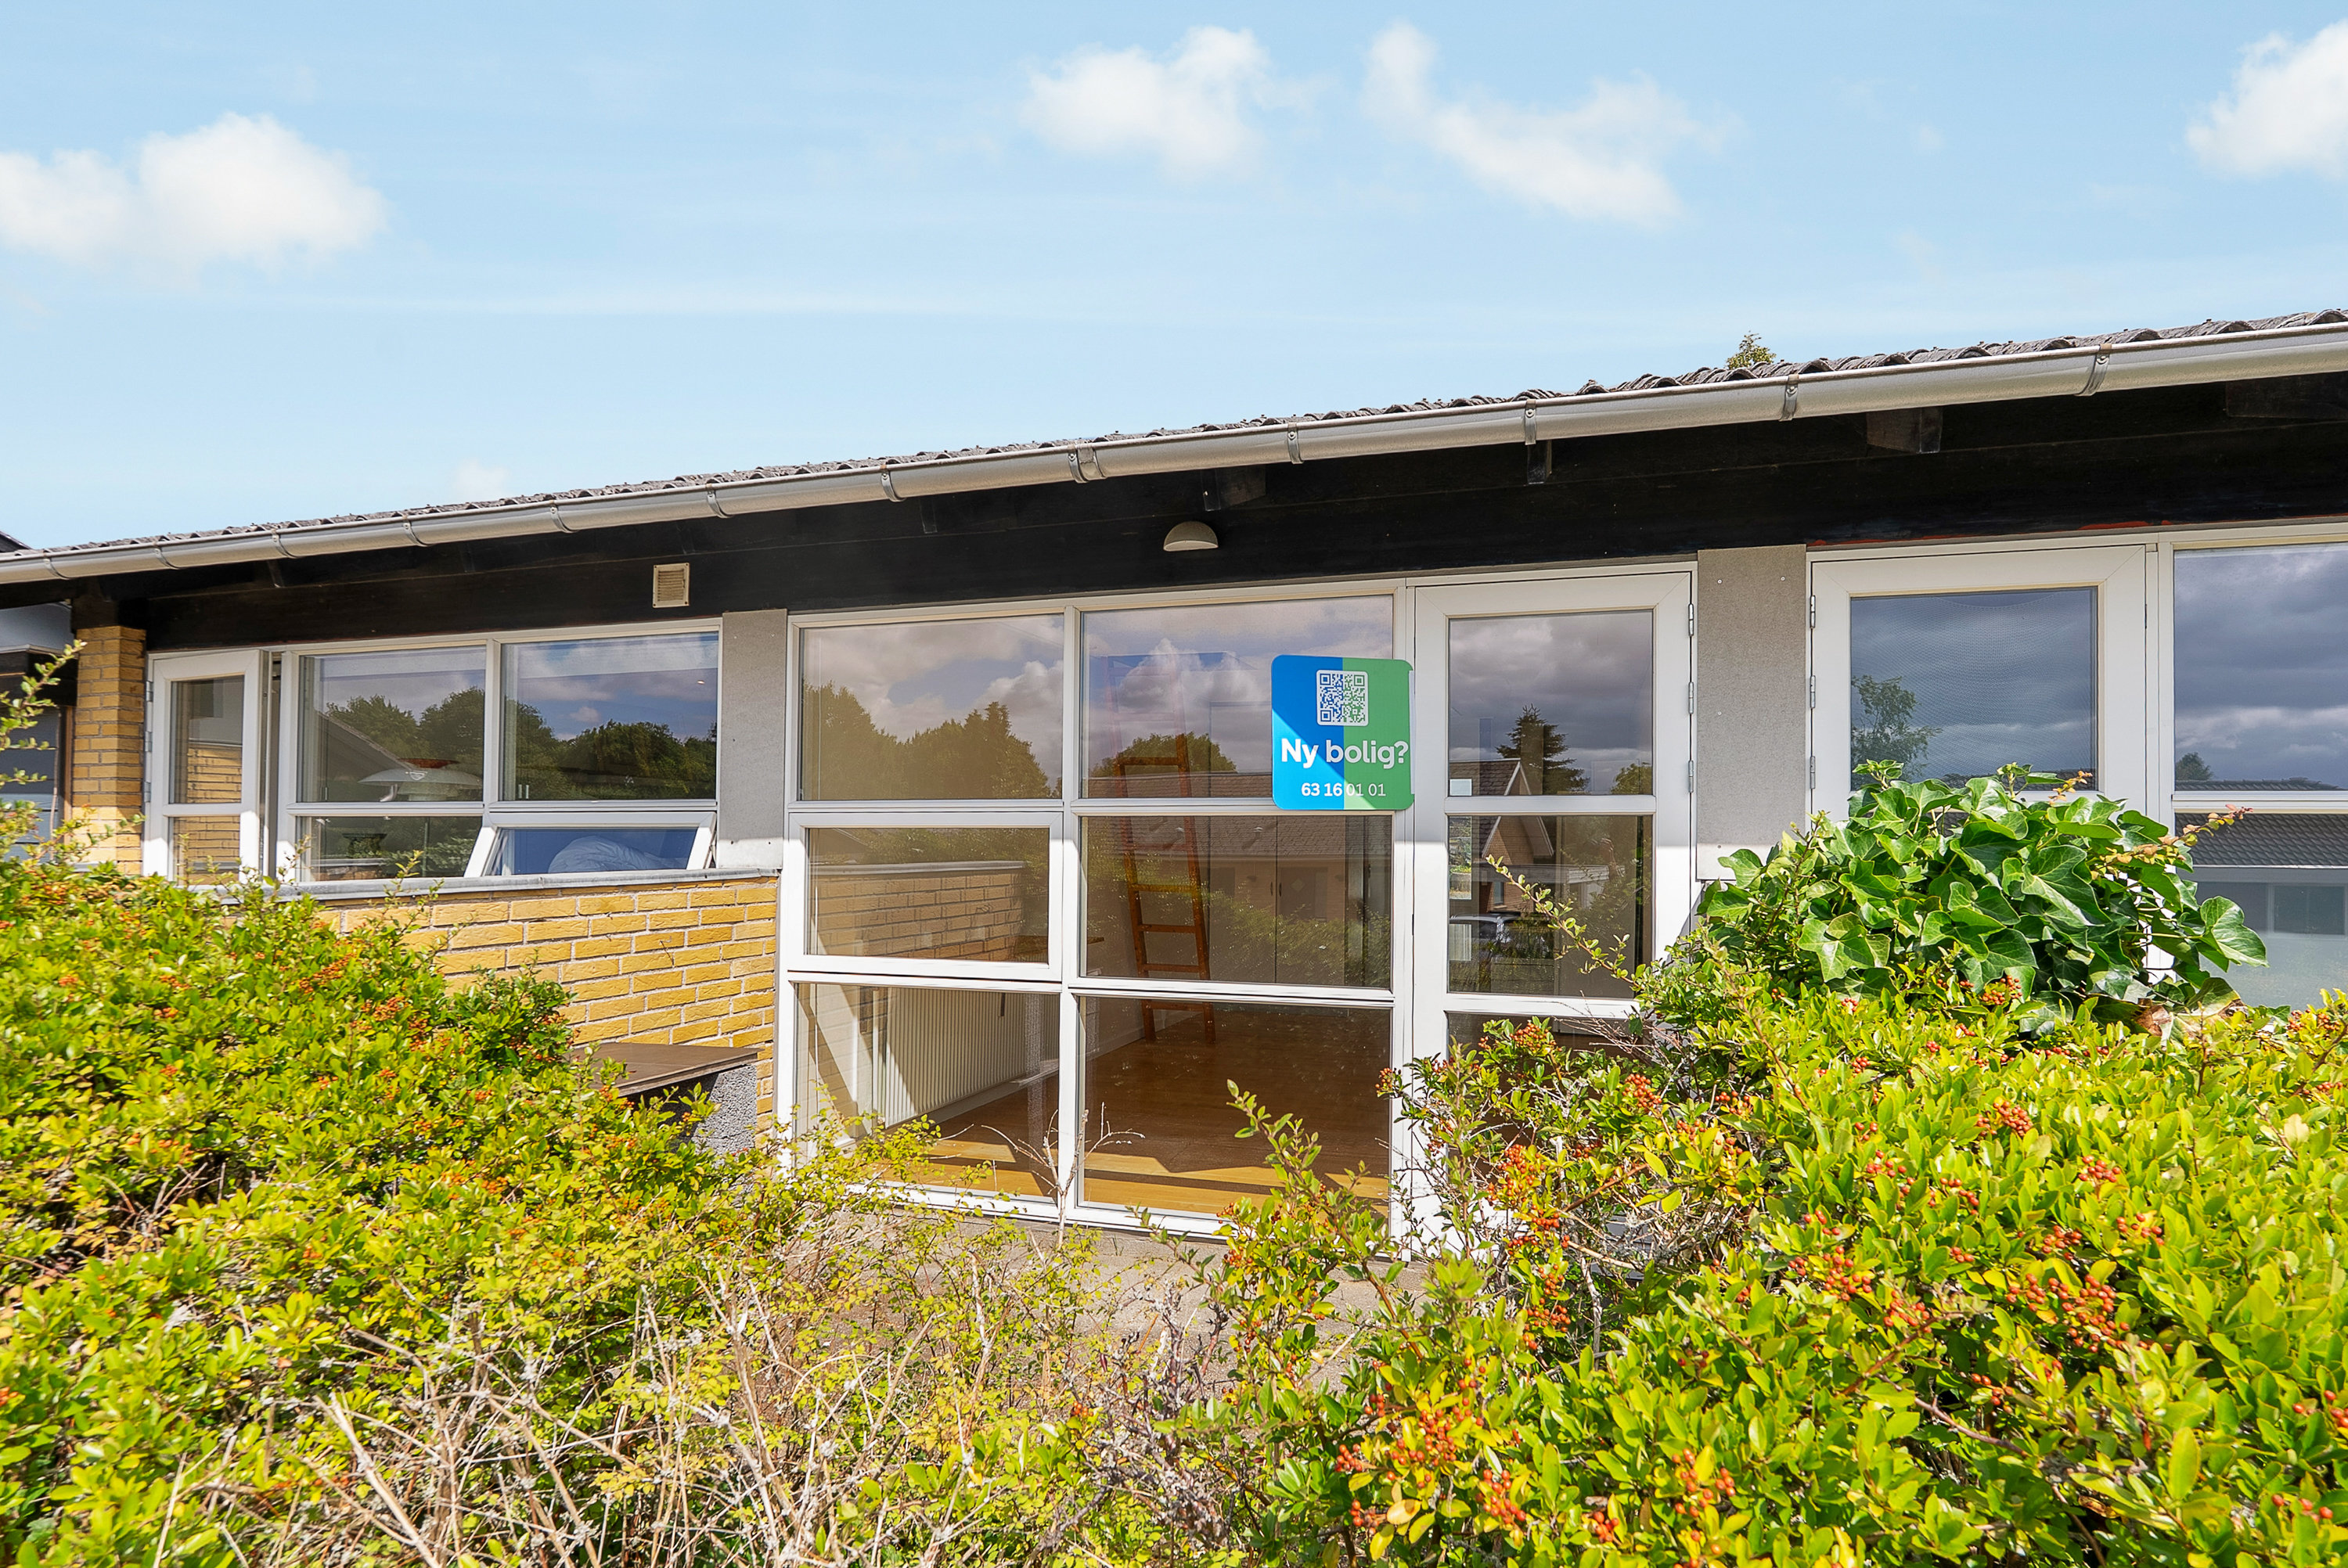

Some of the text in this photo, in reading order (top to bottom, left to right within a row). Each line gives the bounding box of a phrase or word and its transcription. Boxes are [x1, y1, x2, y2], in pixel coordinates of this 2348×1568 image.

[1281, 738, 1409, 769] Ny bolig?
[1301, 782, 1386, 797] 63 16 01 01
